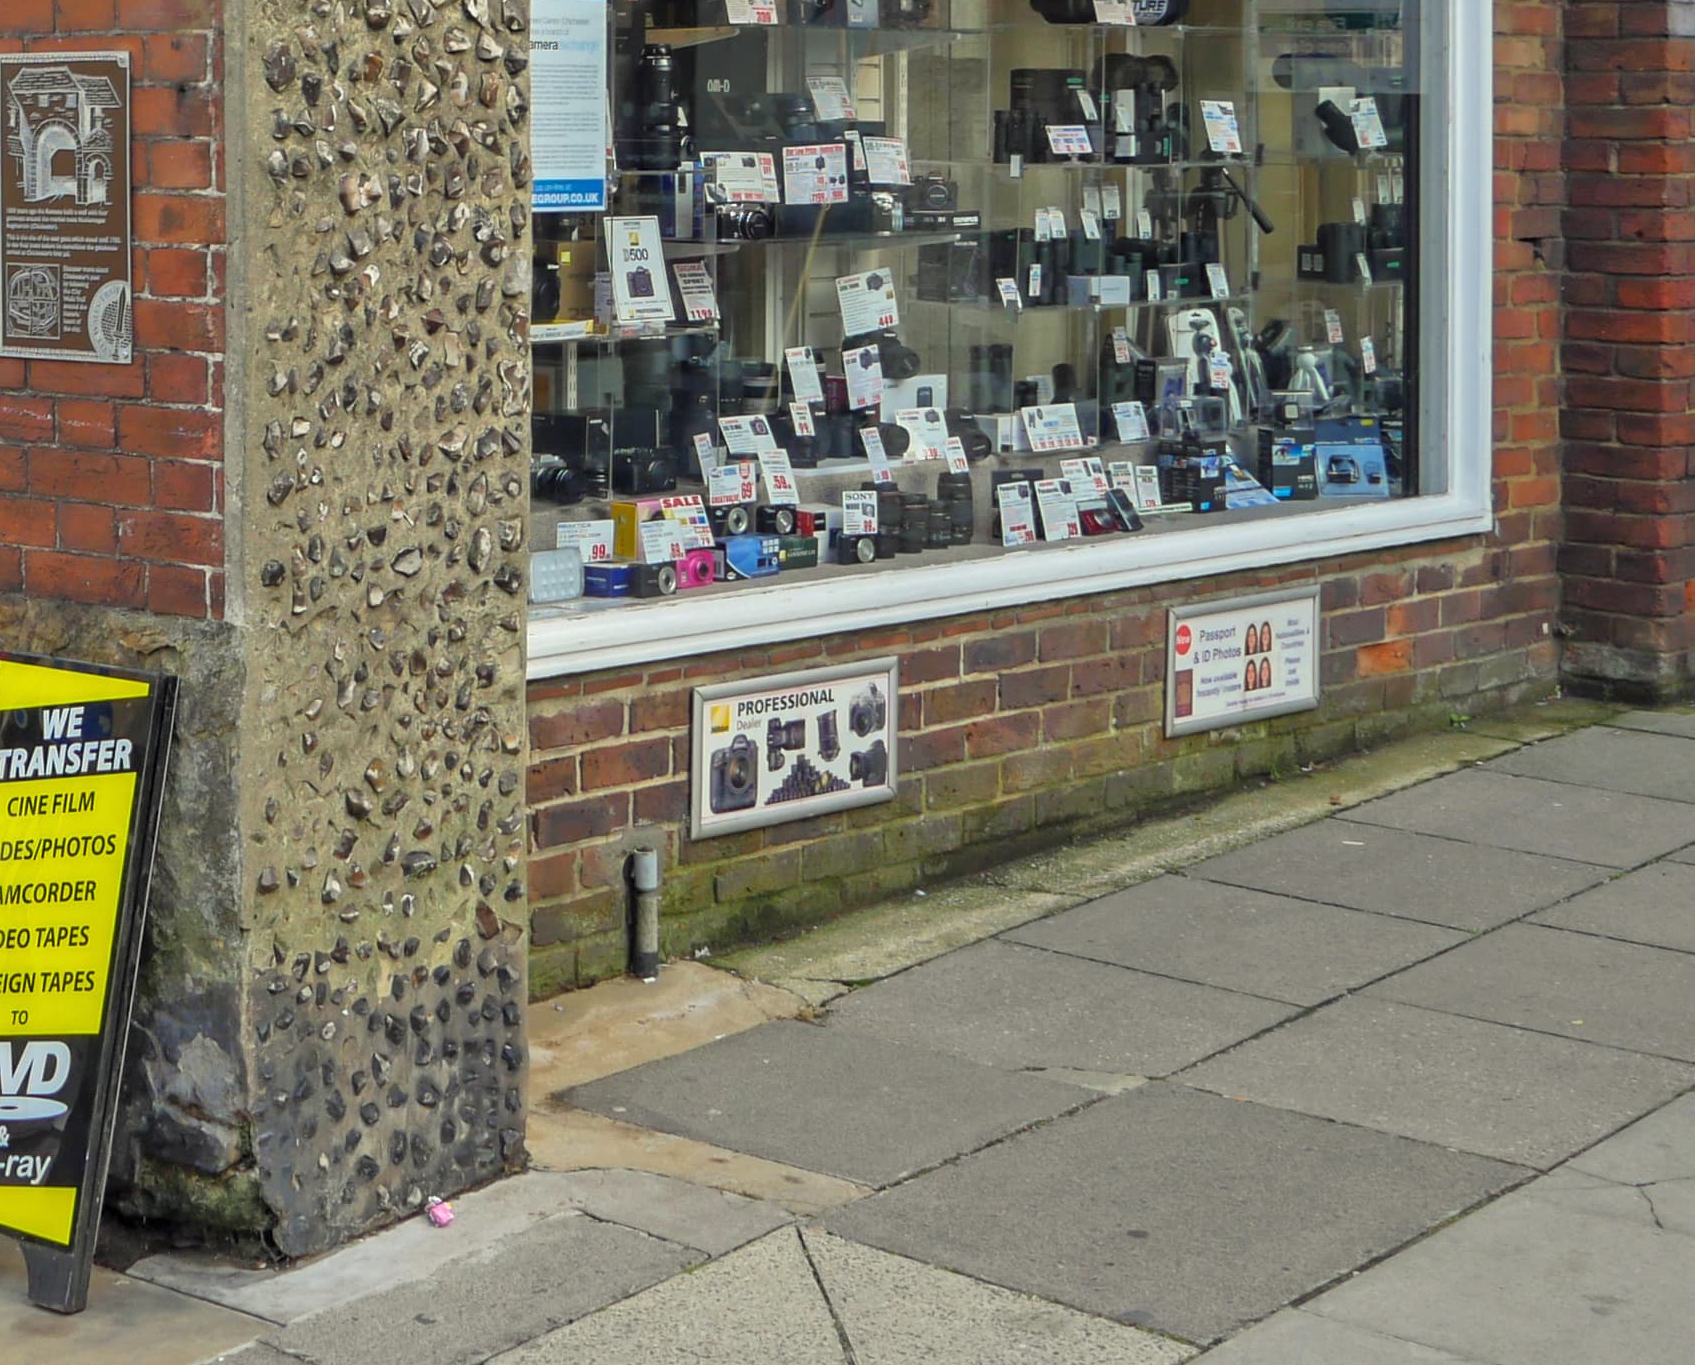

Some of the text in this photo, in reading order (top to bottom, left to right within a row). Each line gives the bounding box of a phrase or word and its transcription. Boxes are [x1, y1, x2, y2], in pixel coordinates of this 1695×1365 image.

[530, 40, 558, 50] amera
[663, 496, 701, 508] SALE
[1200, 627, 1236, 643] Passport
[1194, 647, 1241, 664] & ID Photos
[738, 689, 834, 716] PROFESSIONAL
[42, 706, 84, 740] WE
[736, 719, 762, 732] Dealer
[7, 791, 96, 817] CINE FILM
[35, 926, 89, 947] TAPES
[40, 971, 95, 992] TAPES
[11, 1010, 29, 1025] TO
